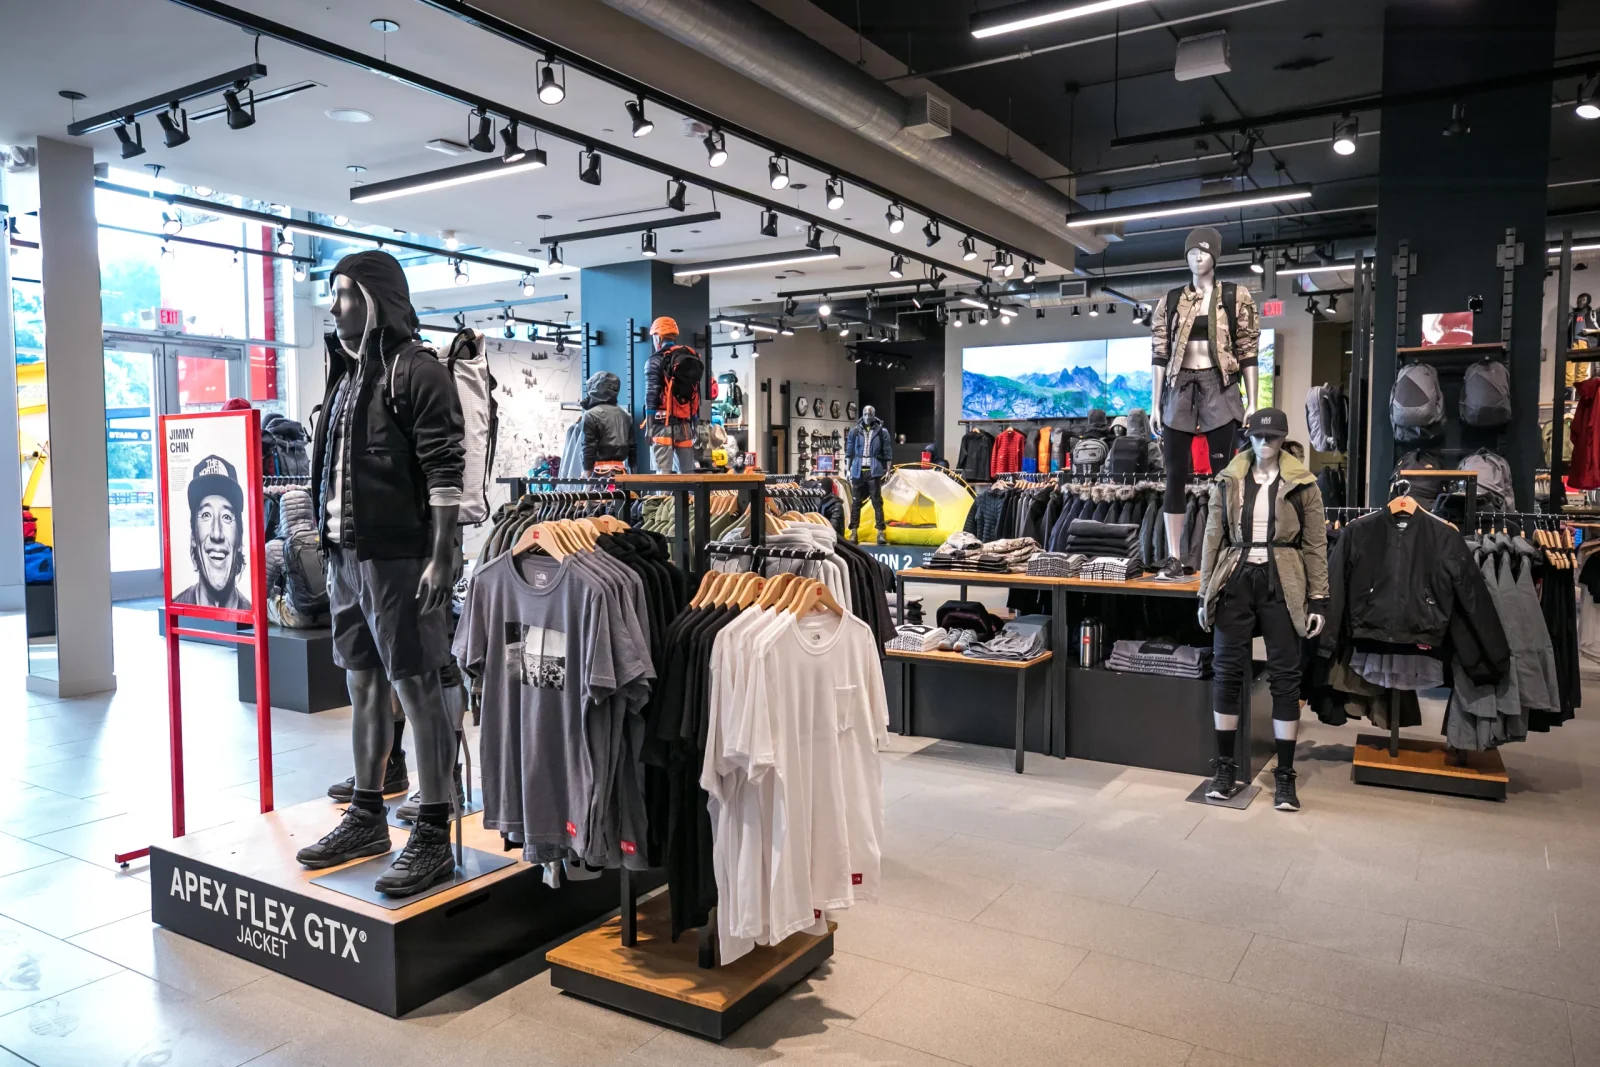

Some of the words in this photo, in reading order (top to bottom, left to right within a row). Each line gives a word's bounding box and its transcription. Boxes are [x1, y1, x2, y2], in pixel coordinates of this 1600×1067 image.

[1263, 301, 1283, 316] EXIT
[160, 309, 179, 324] EXIT
[169, 428, 194, 440] JIMMY
[169, 442, 189, 453] CHIN
[206, 458, 219, 467] THE
[903, 555, 912, 570] 2
[170, 867, 229, 916] APEX
[235, 887, 297, 941] FLEX
[236, 925, 288, 959] JACKET
